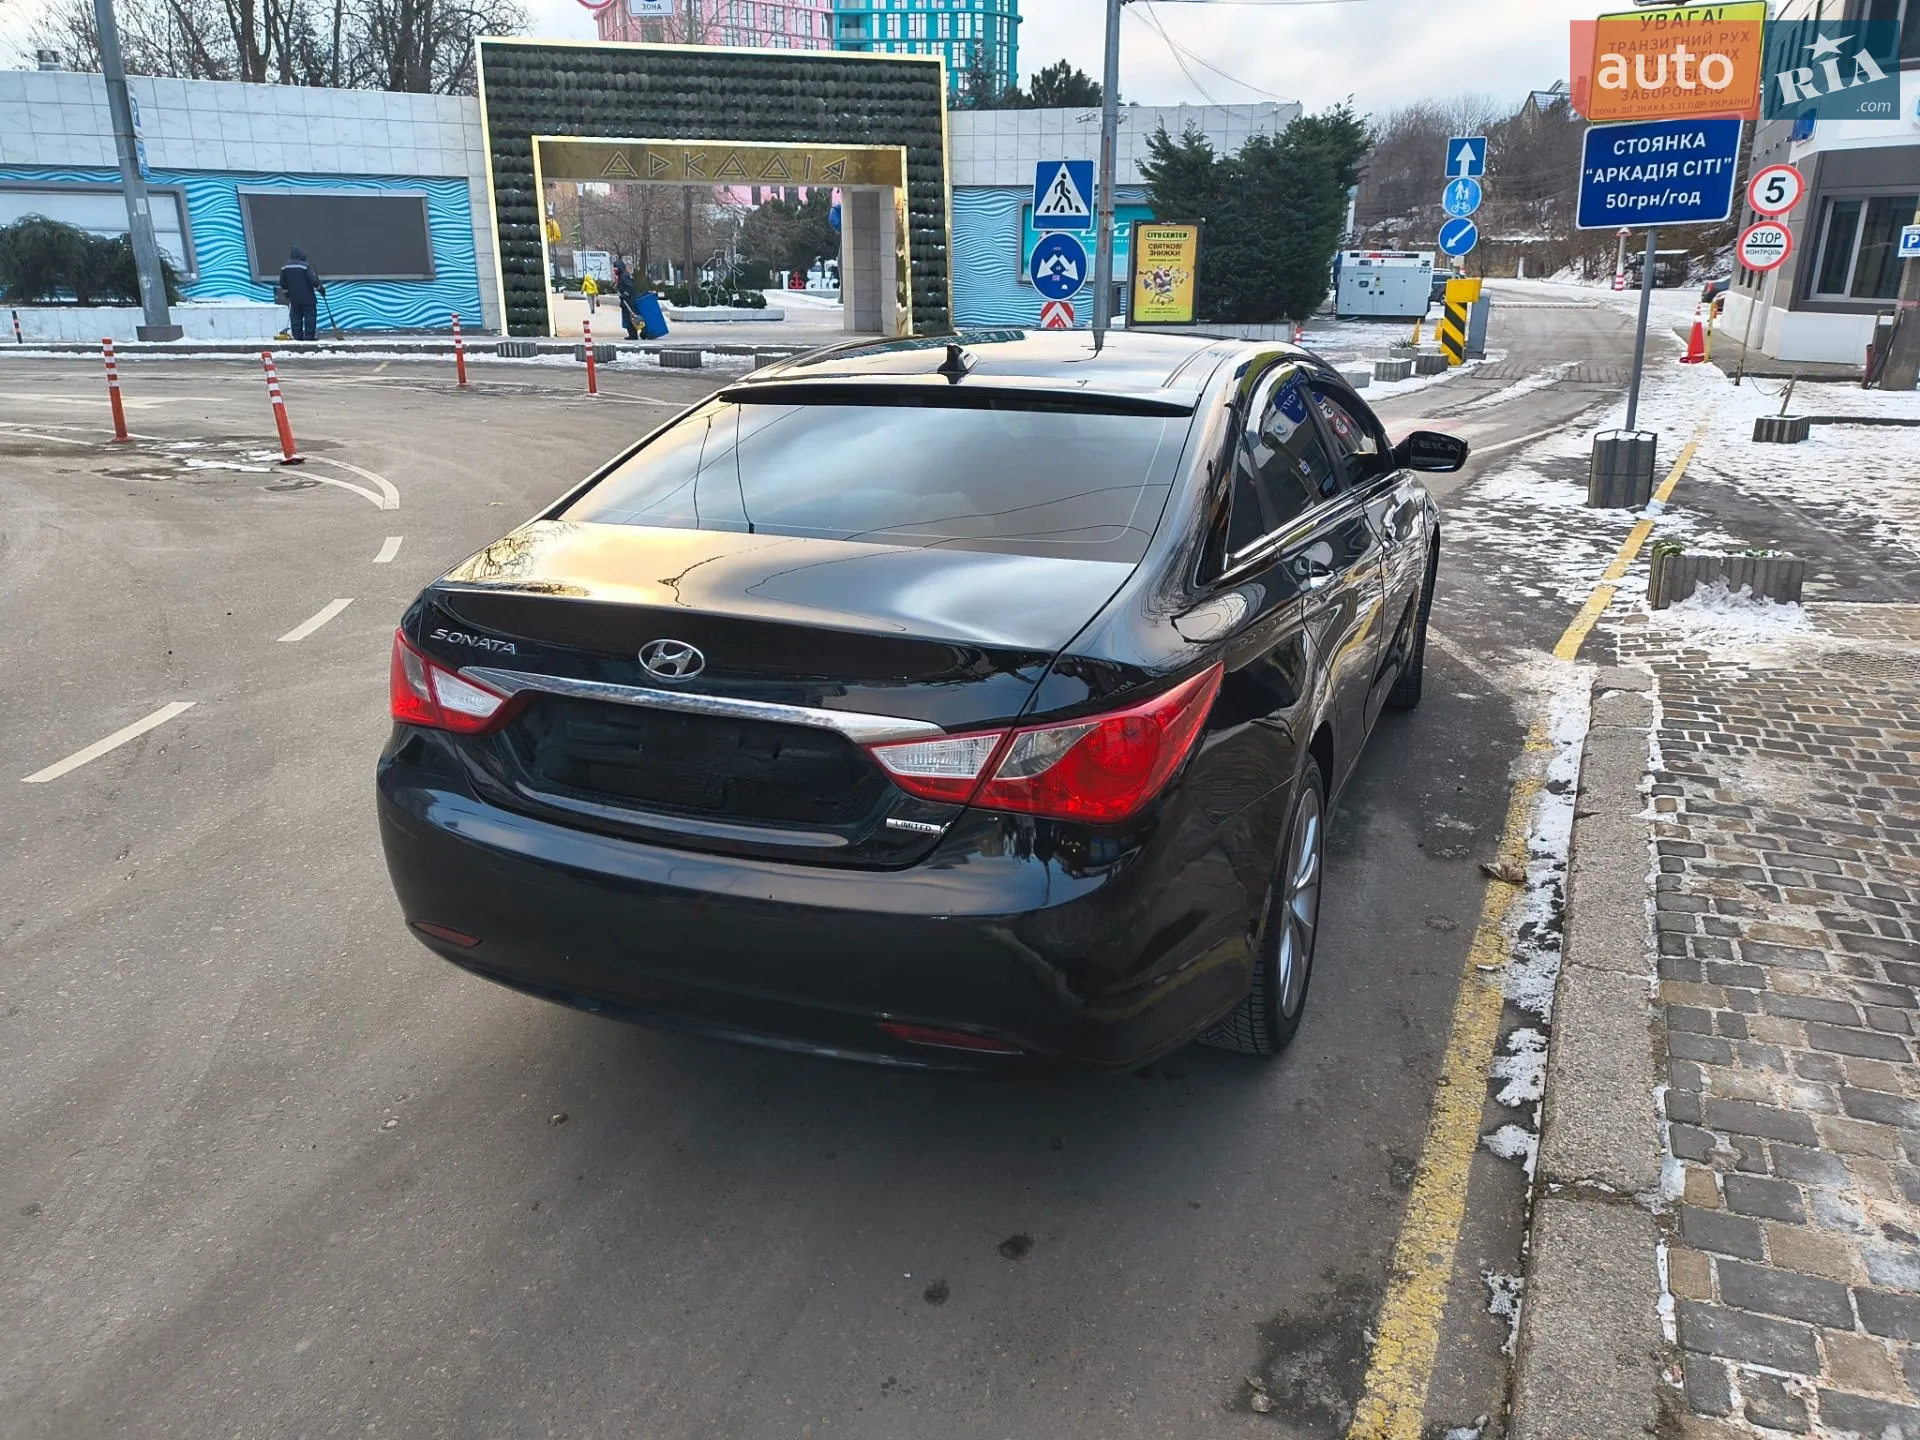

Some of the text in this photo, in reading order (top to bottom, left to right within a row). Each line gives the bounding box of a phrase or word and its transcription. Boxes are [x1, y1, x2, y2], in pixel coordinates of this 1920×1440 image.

[641, 3, 662, 11] ЗОНА
[1640, 8, 1723, 32] УВАГА!
[1719, 30, 1751, 45] РУХ
[1613, 132, 1706, 155] СТОЯНКА
[1606, 188, 1701, 210] 50грн/год
[1765, 177, 1786, 204] 5
[1751, 232, 1782, 244] STOP
[1745, 248, 1782, 256] КОНТРОЛЬ
[430, 628, 516, 655] SONATA
